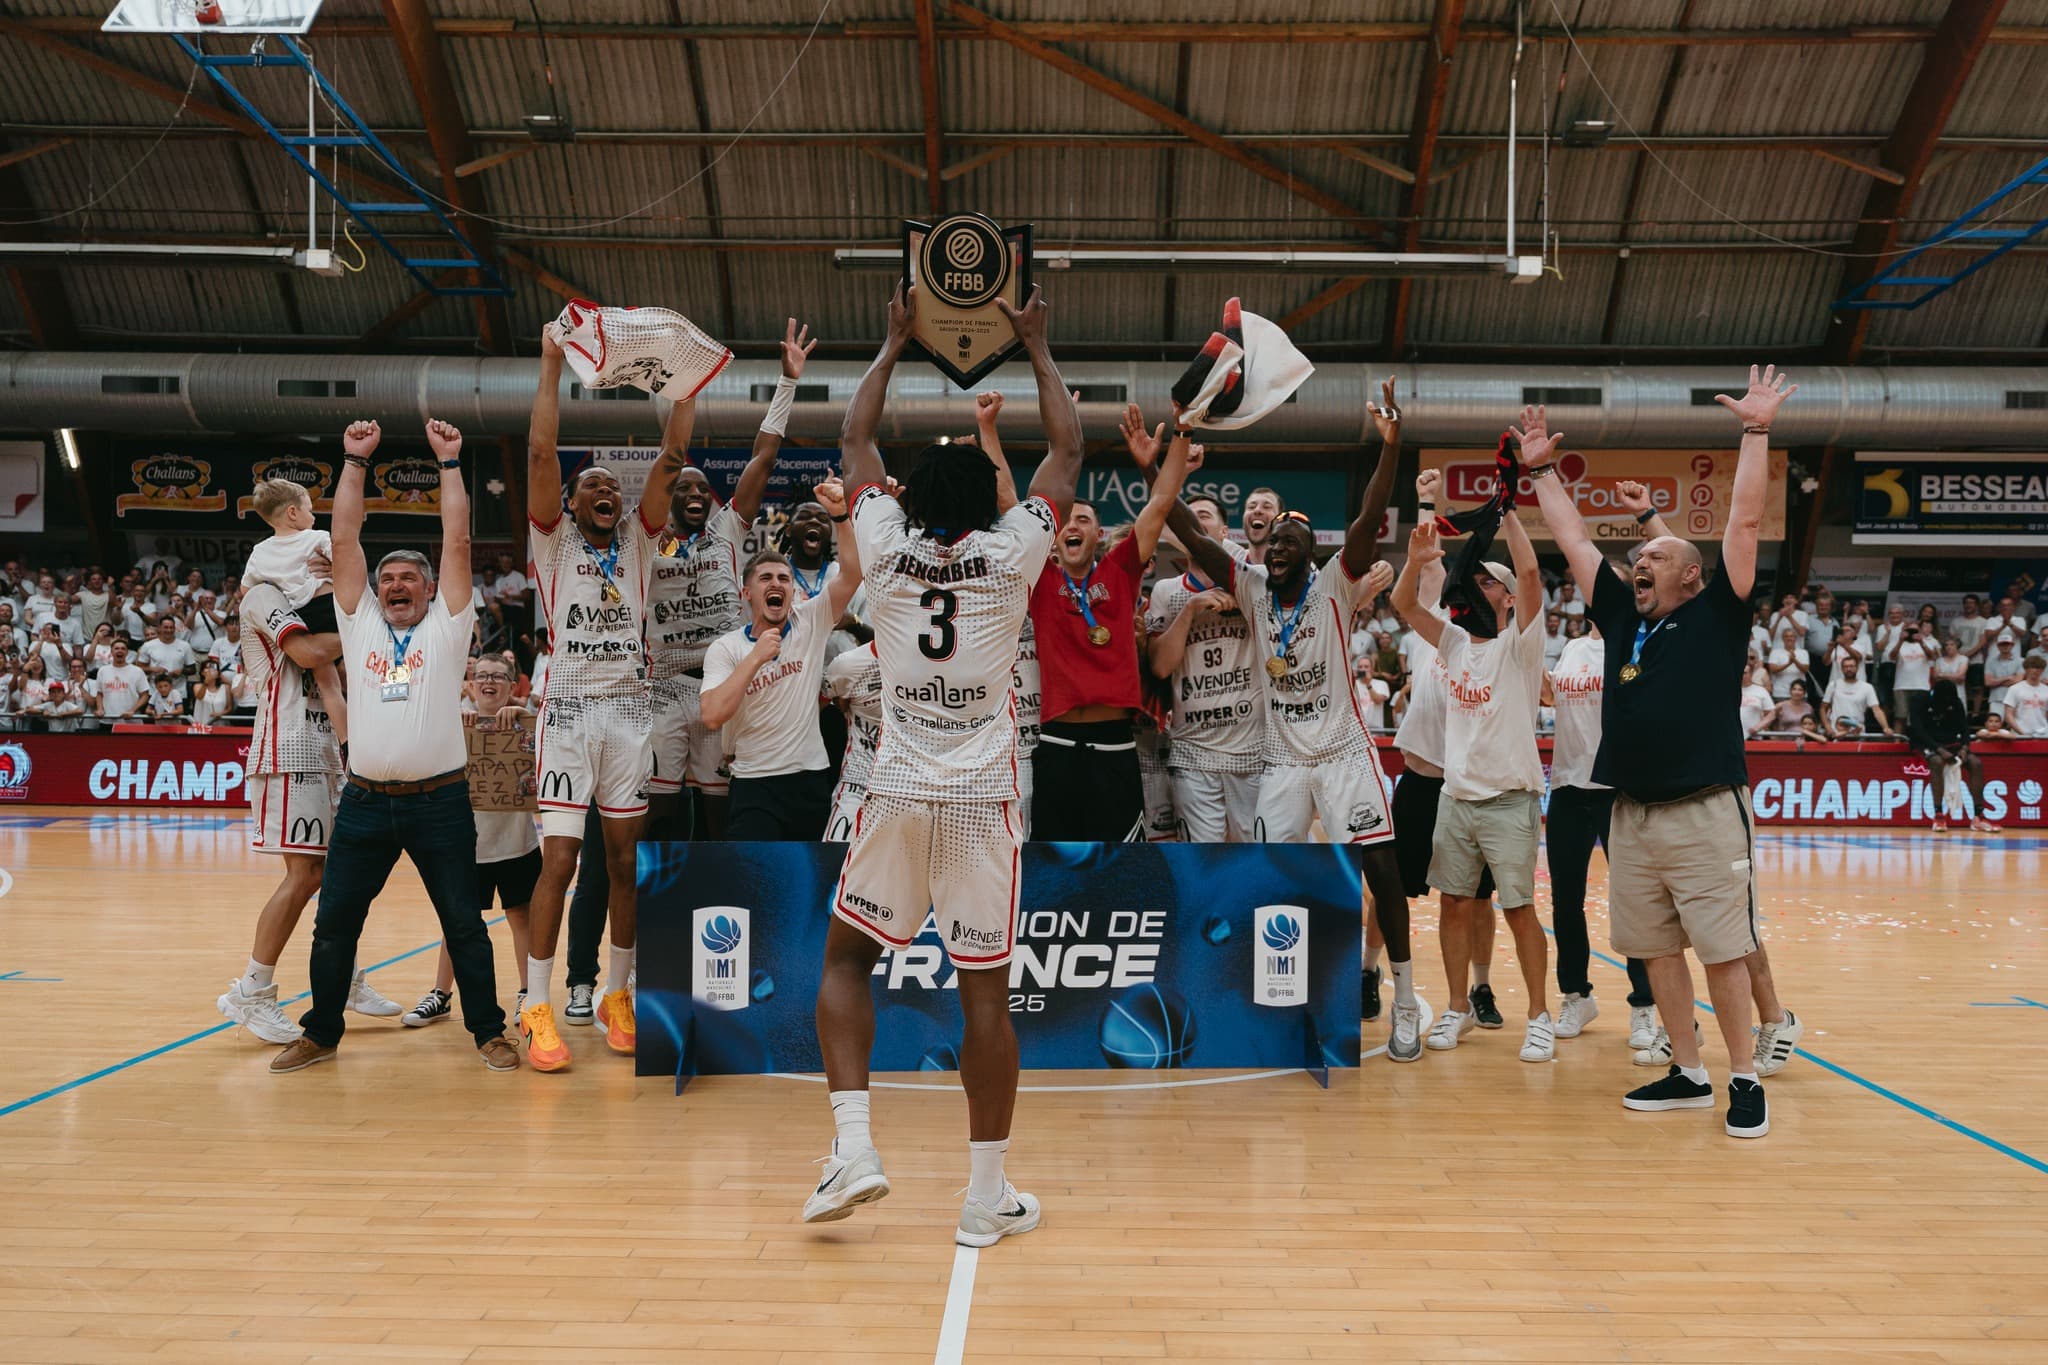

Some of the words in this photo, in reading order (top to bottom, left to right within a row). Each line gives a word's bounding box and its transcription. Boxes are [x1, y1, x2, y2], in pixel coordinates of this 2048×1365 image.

[944, 272, 985, 292] FFBB
[145, 464, 196, 482] Challans
[388, 468, 440, 485] Challans
[1920, 474, 2048, 501] BESSEA
[918, 588, 960, 663] 3
[567, 640, 622, 654] HYPER
[586, 652, 628, 662] Challans
[1203, 647, 1223, 669] 93
[1193, 667, 1251, 691] VENDÉE
[1184, 706, 1233, 723] HYPER
[1201, 718, 1239, 730] Challans
[846, 892, 879, 915] HYPER
[1108, 911, 1167, 938] DE
[962, 925, 1003, 944] VENDÉE
[705, 958, 737, 978] NM1
[1266, 956, 1296, 975] NM1
[718, 993, 735, 1001] FFBB
[1278, 989, 1295, 997] FFBB
